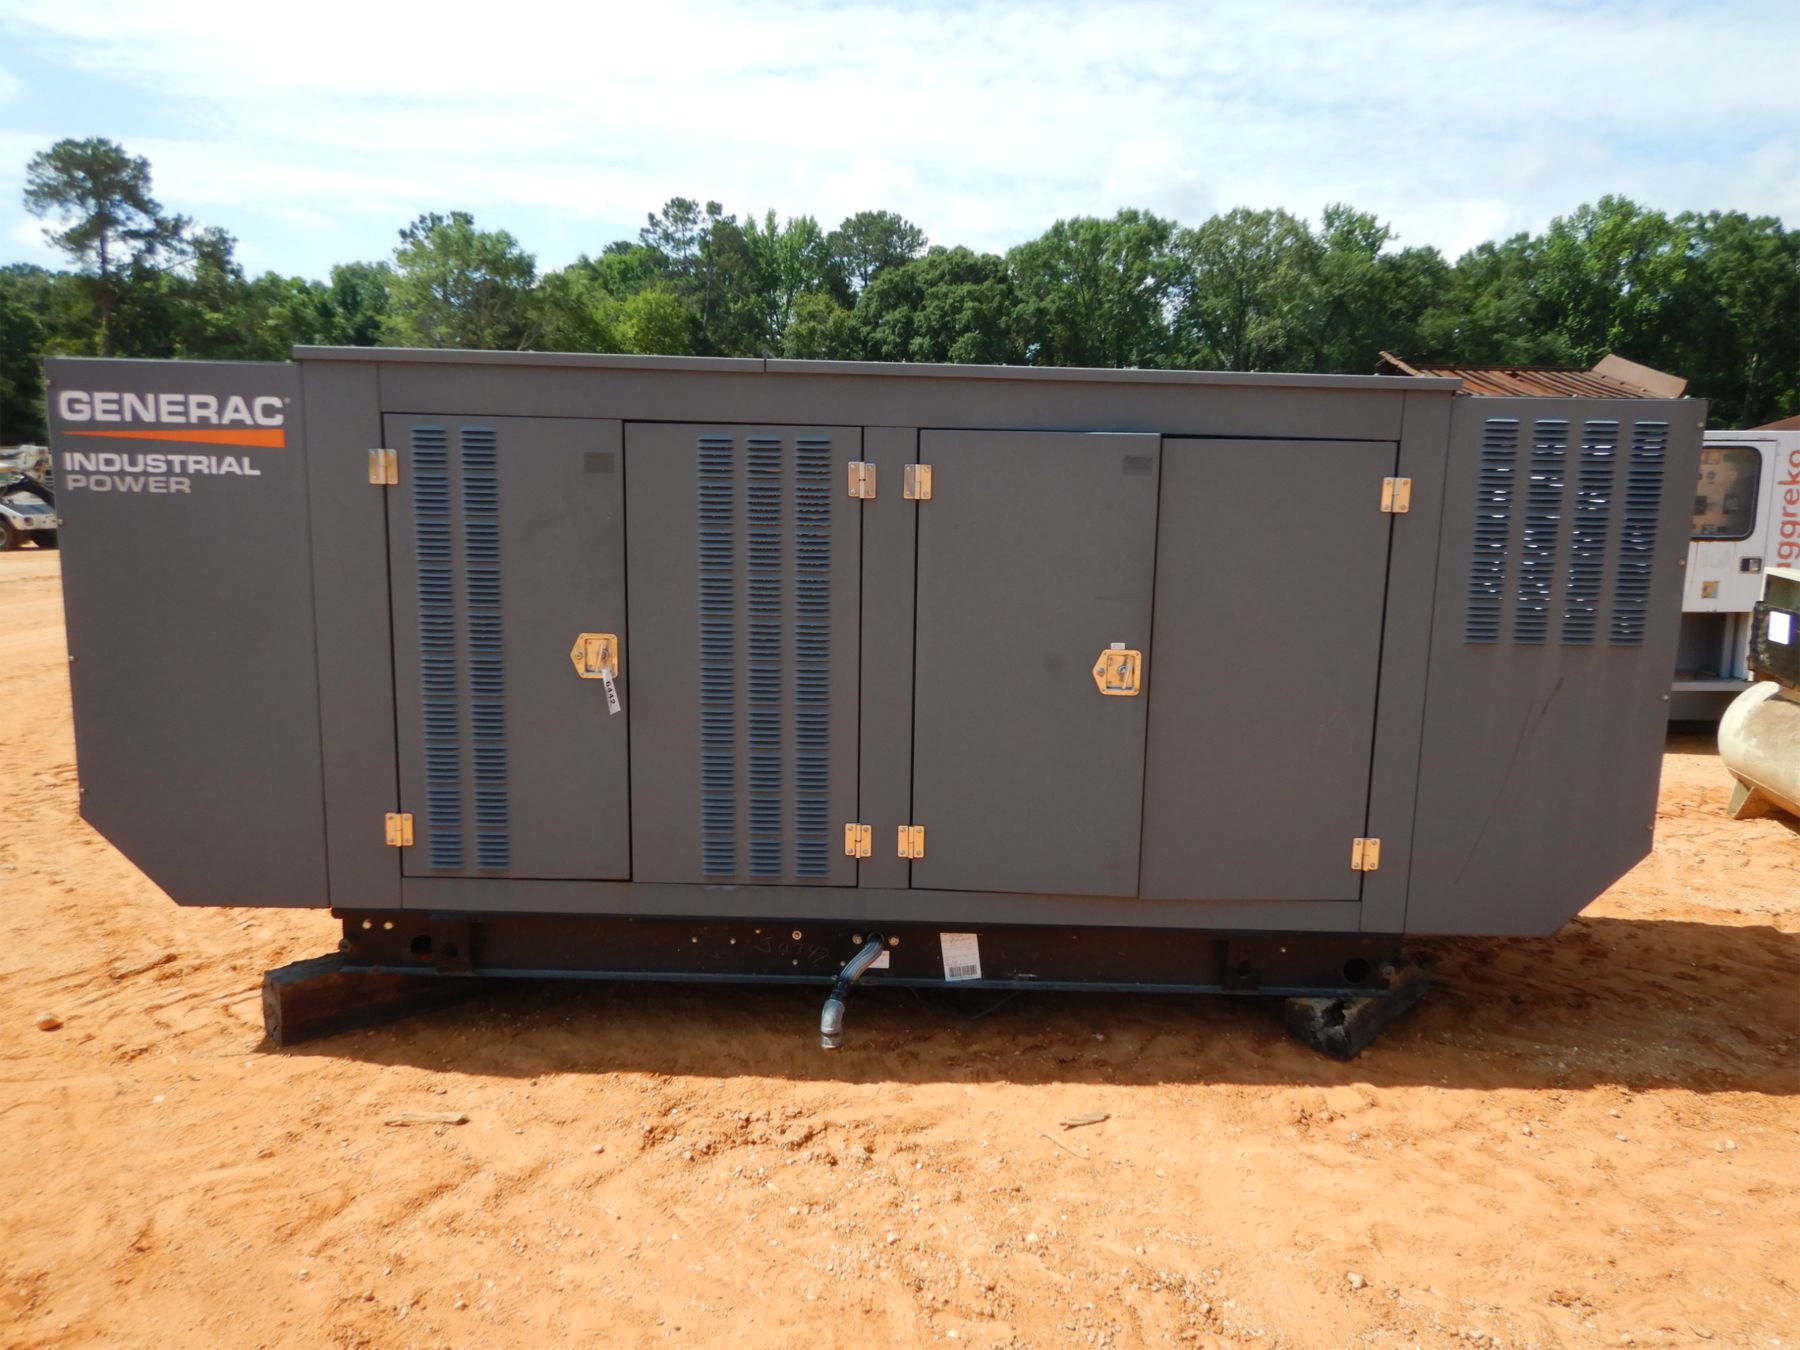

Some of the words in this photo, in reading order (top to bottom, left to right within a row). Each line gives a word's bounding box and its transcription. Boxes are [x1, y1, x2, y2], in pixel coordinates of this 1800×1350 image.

[58, 390, 285, 426] GENERAC
[64, 452, 261, 476] INDUSTRIAL
[66, 474, 192, 493] POWER
[1776, 449, 1800, 568] ggreko
